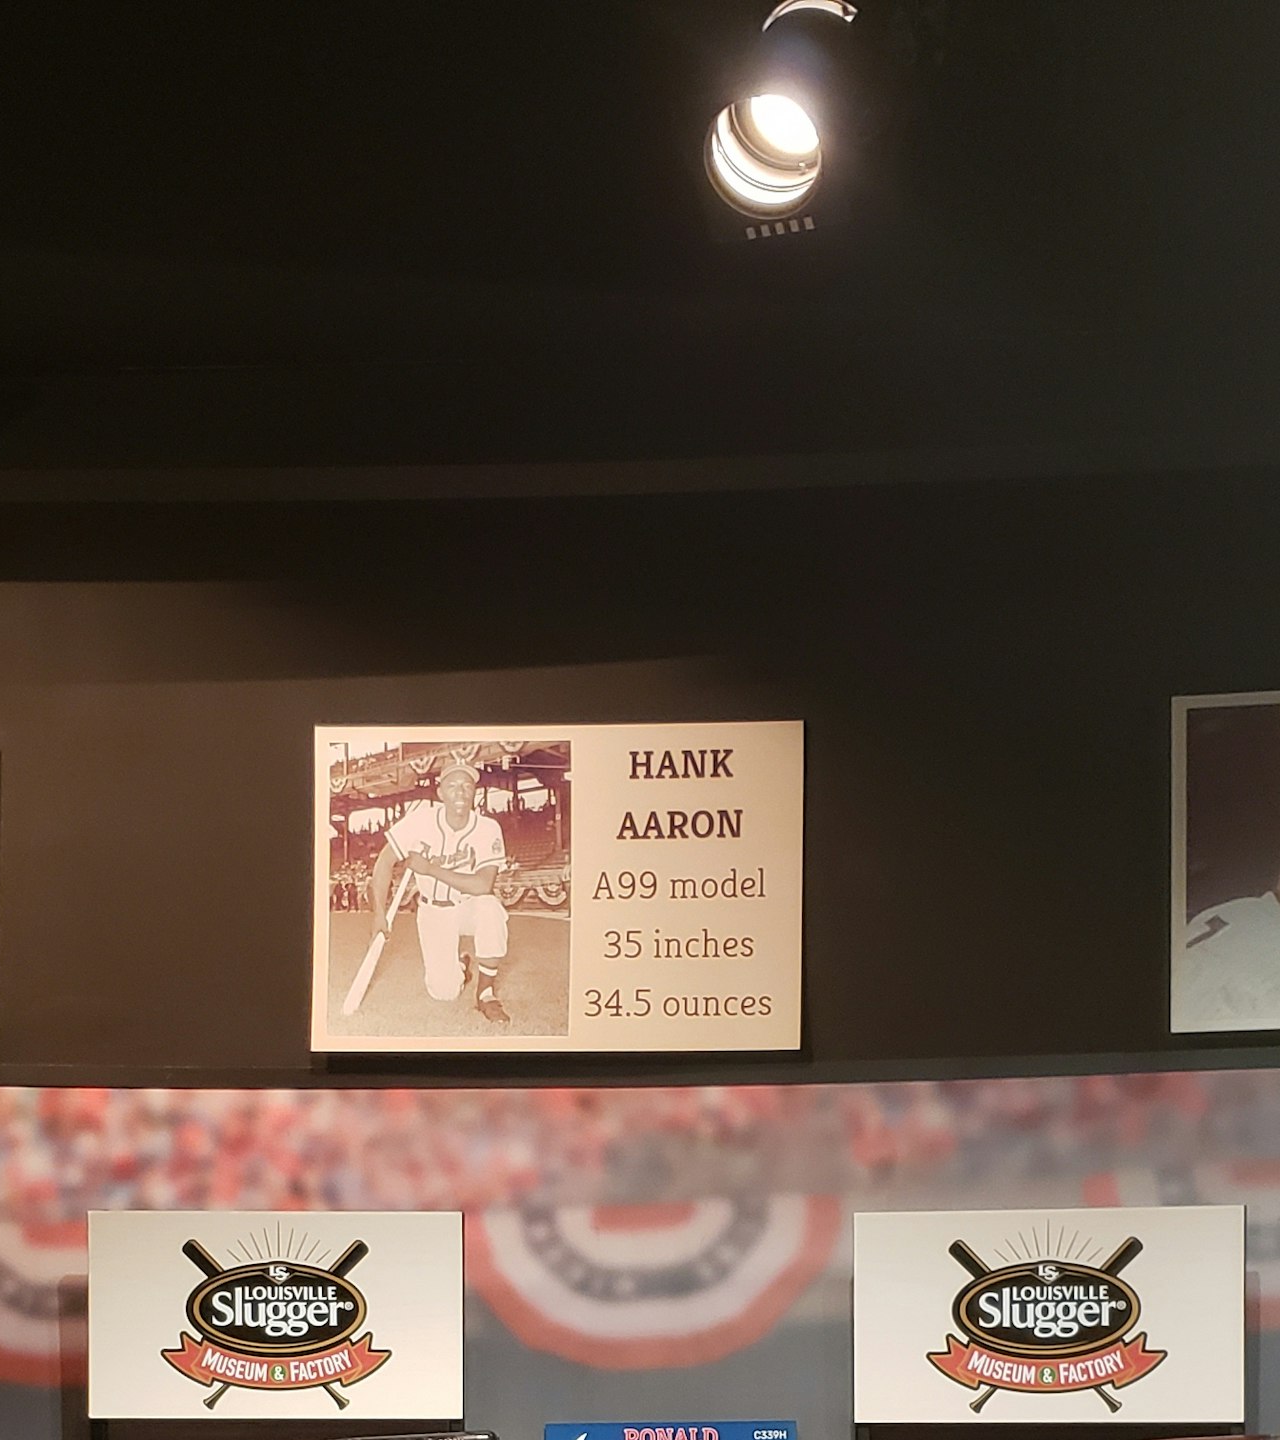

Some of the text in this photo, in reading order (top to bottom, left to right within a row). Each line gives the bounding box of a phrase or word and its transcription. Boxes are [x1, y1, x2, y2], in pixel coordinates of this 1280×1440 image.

[629, 749, 733, 780] HANK
[617, 810, 743, 840] AARON
[593, 869, 765, 900] A99 model
[604, 929, 754, 959] 35 inches
[584, 990, 772, 1018] 34.5 ounces
[244, 1286, 336, 1301] LOUISVILLE
[1013, 1285, 1108, 1300] LOUISVILLE
[202, 1349, 353, 1382] MUSEUM & FACTORY
[968, 1350, 1123, 1384] MUSEUM & FACTORY
[754, 1431, 787, 1440] C339H
